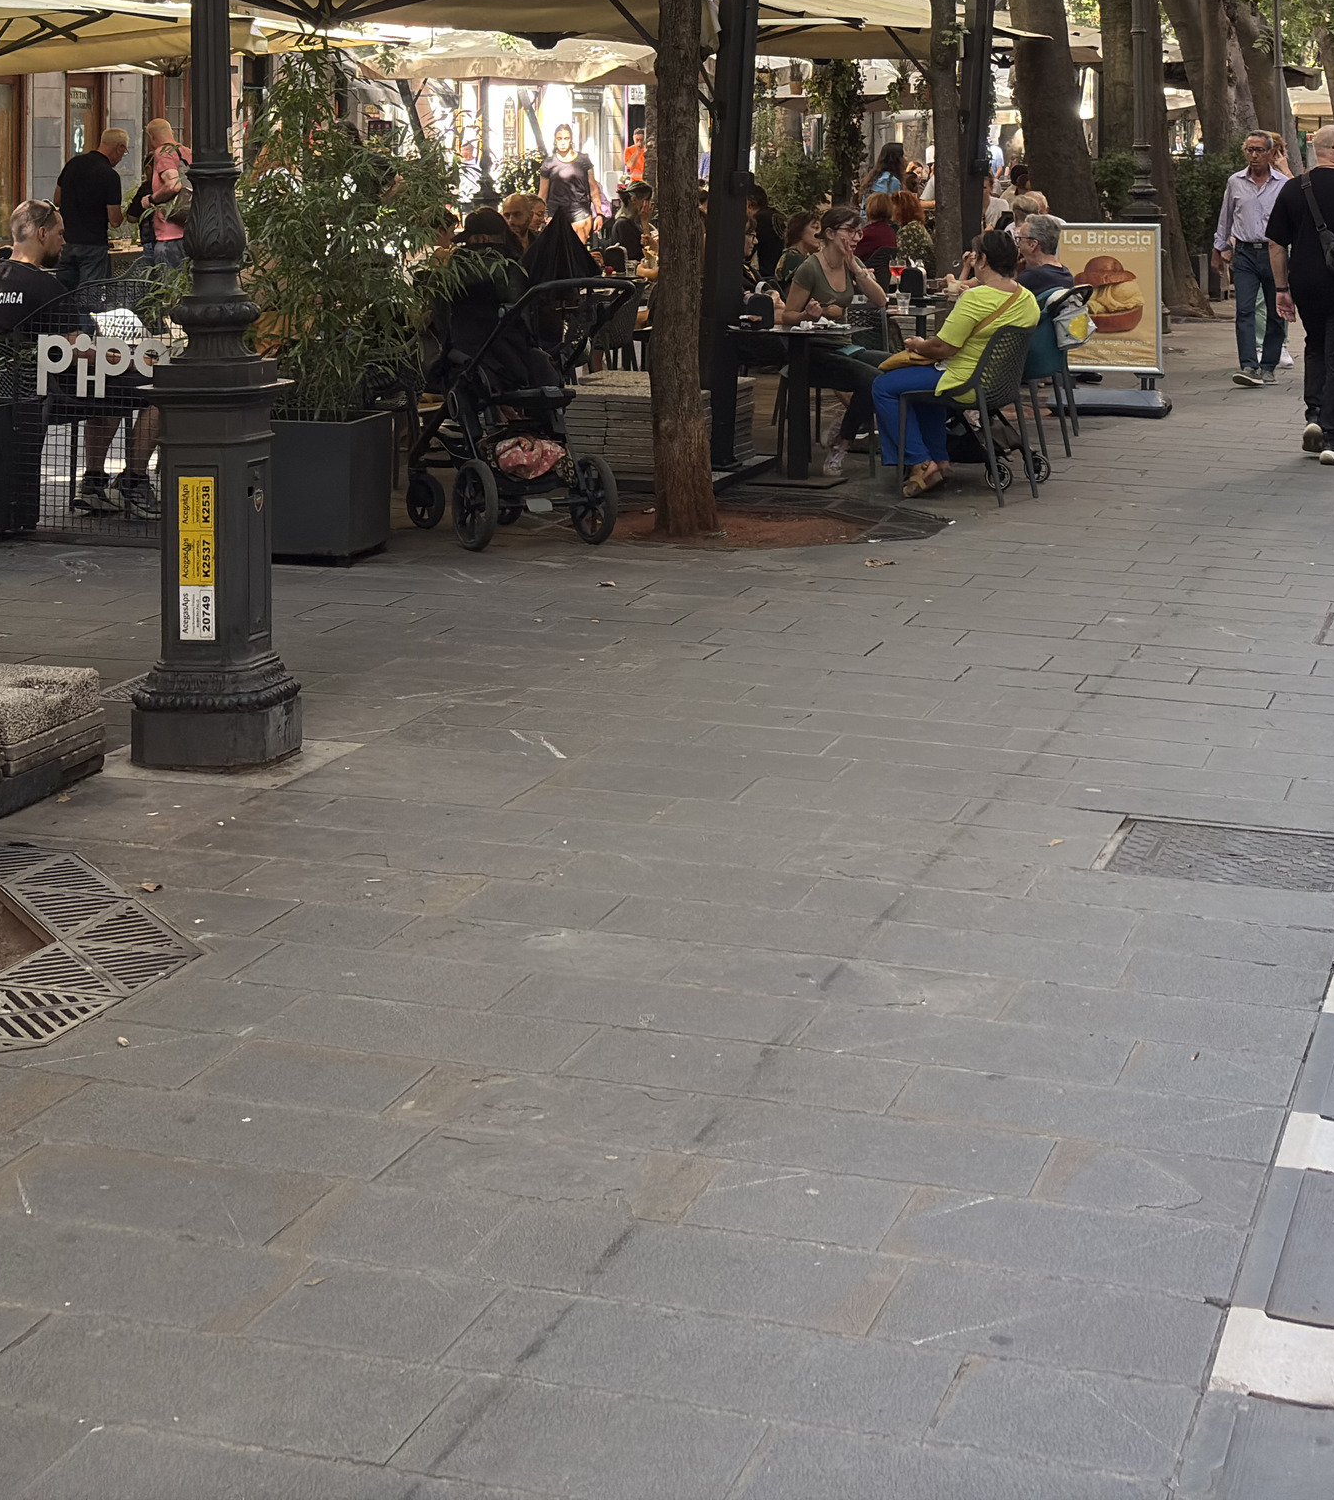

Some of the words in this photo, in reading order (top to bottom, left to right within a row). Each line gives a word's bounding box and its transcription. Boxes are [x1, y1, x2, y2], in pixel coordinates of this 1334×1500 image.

[1063, 230, 1082, 245] La
[1087, 231, 1151, 245] Brioscia
[182, 483, 190, 525] AcegasAps
[202, 485, 211, 524] K2538
[182, 537, 190, 579] AcegasAps
[202, 539, 211, 578] K2537
[182, 592, 190, 634] AcegasAps
[202, 595, 211, 632] 20749
